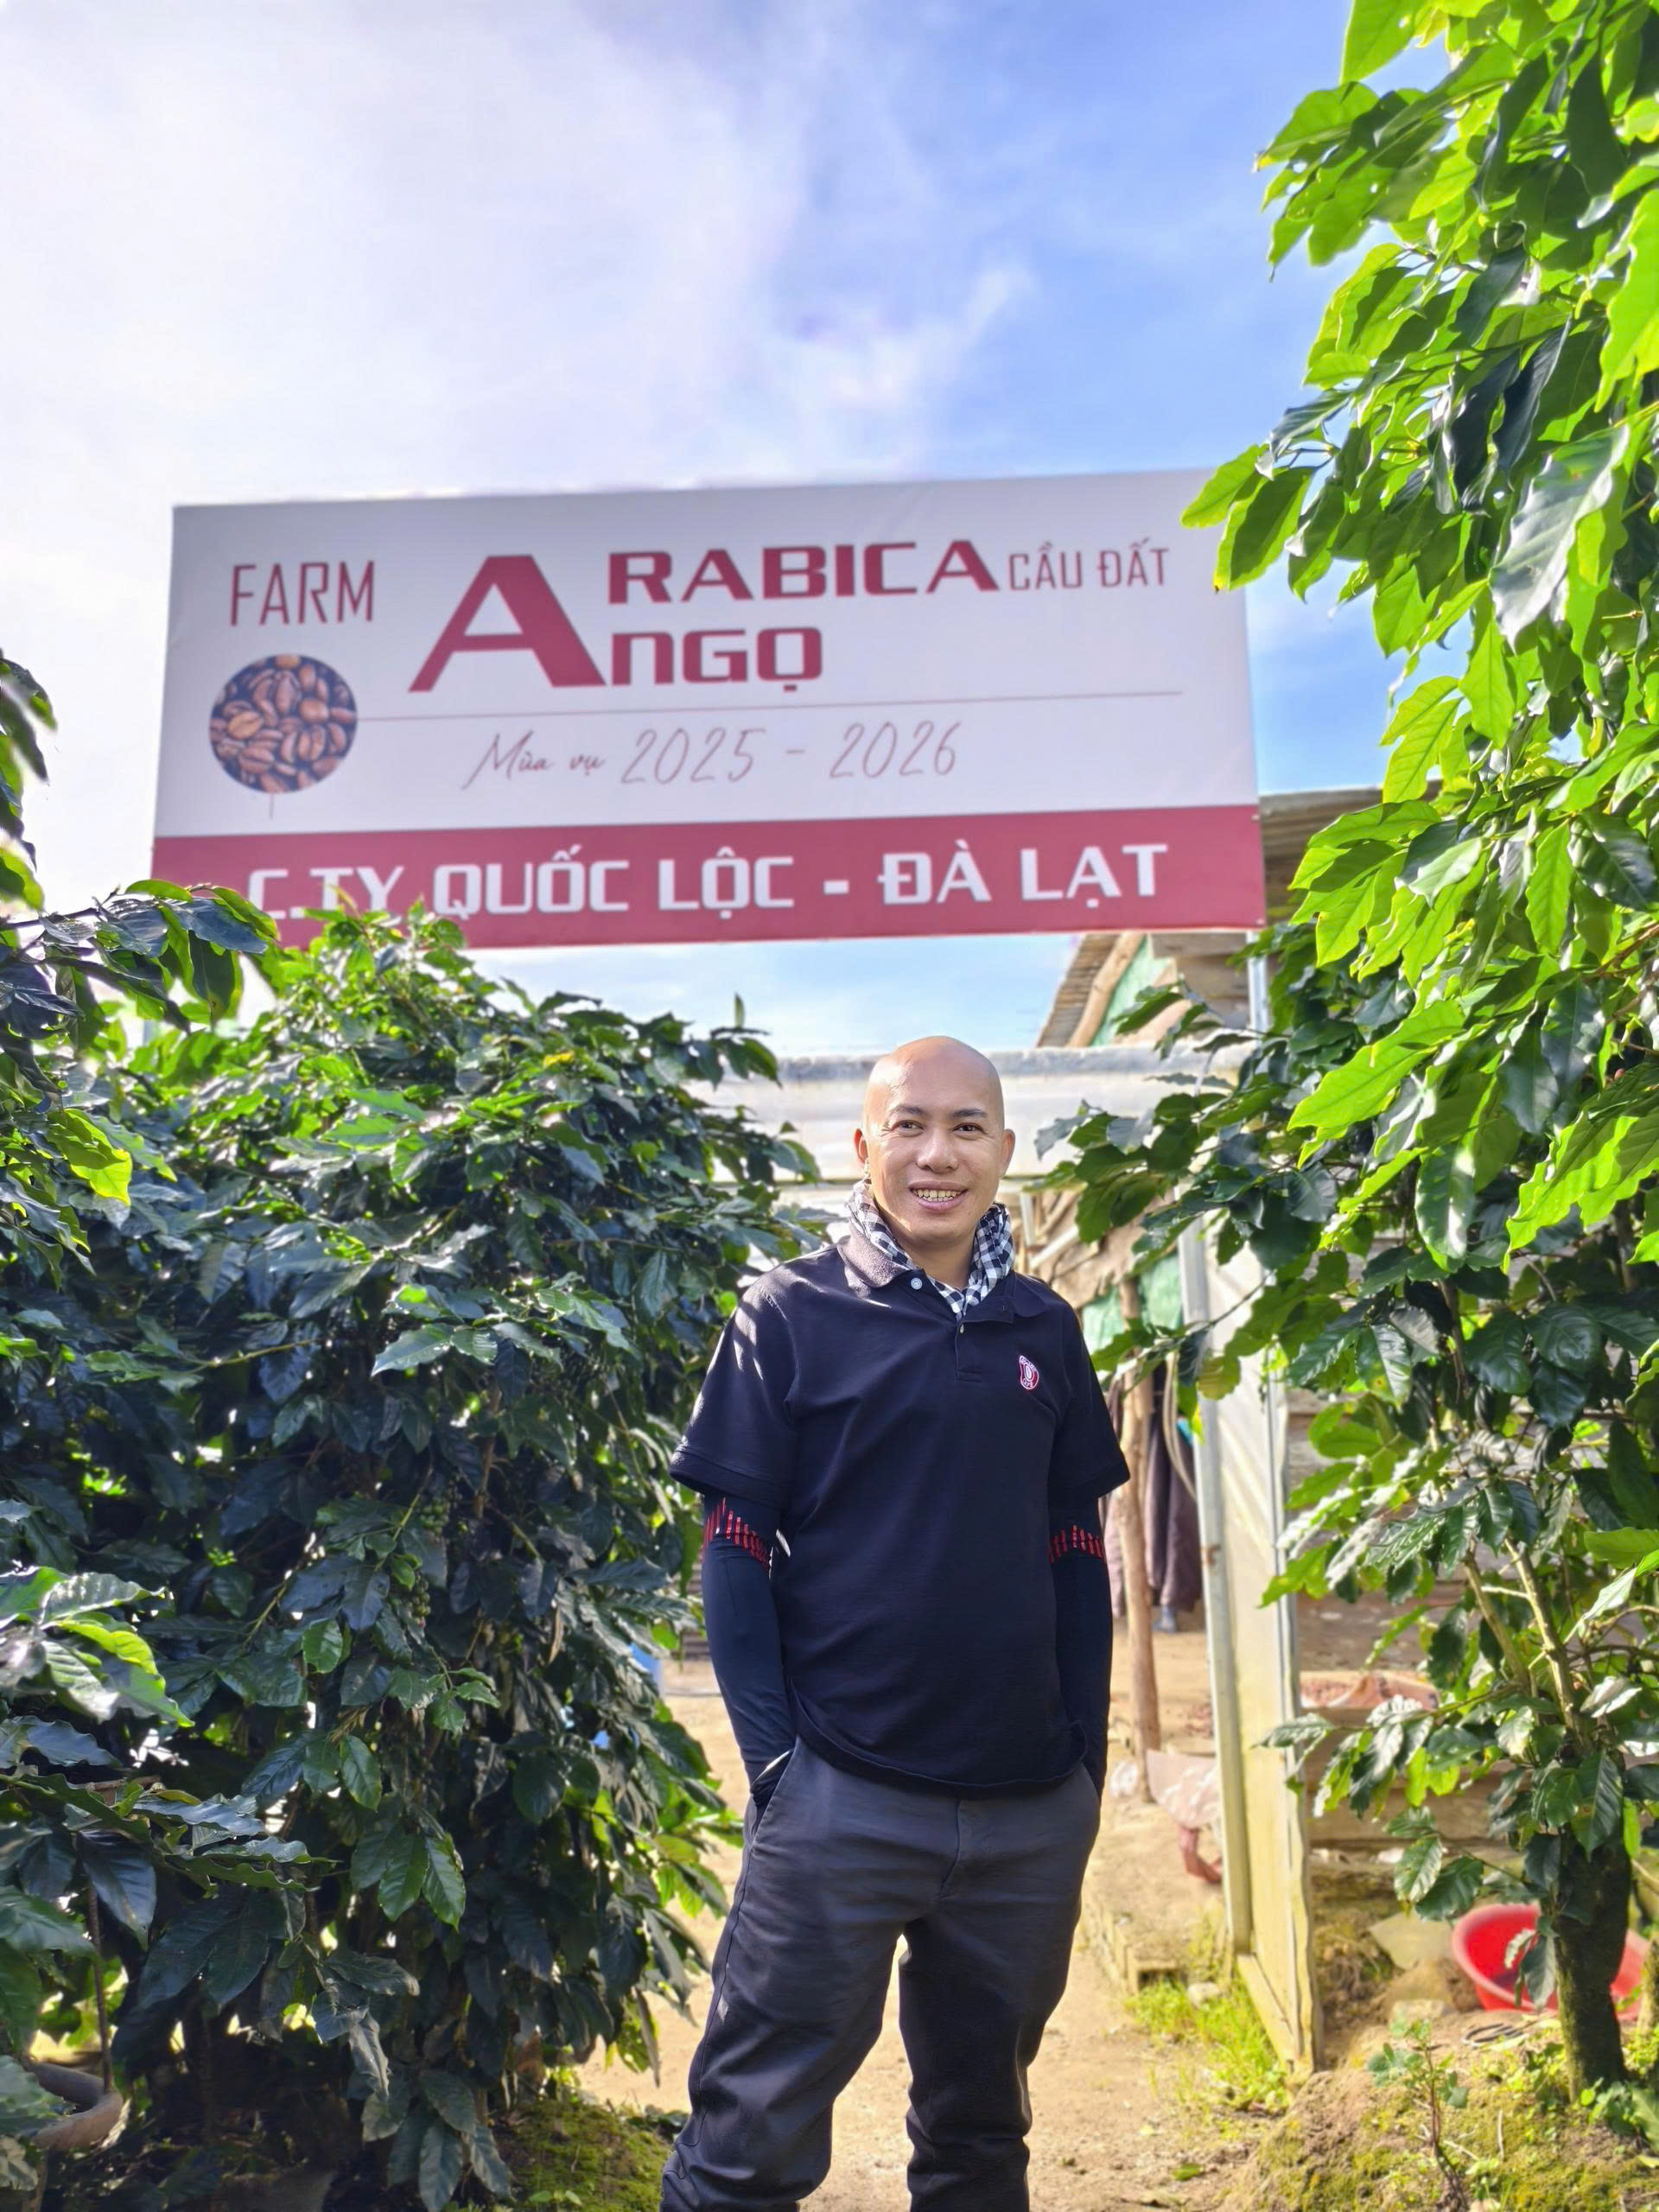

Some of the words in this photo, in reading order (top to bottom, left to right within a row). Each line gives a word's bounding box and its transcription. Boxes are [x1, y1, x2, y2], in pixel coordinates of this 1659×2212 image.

[230, 559, 375, 626] FARM
[1008, 541, 1084, 590] CẦU
[1097, 537, 1169, 588] ĐẤT
[620, 728, 767, 785] 2025
[828, 721, 962, 780] 2026
[434, 844, 631, 920] QUỐC
[658, 847, 794, 919] LỘC
[823, 880, 849, 895] -
[877, 839, 992, 906] ĐÀ
[1020, 843, 1168, 909] LẠT
